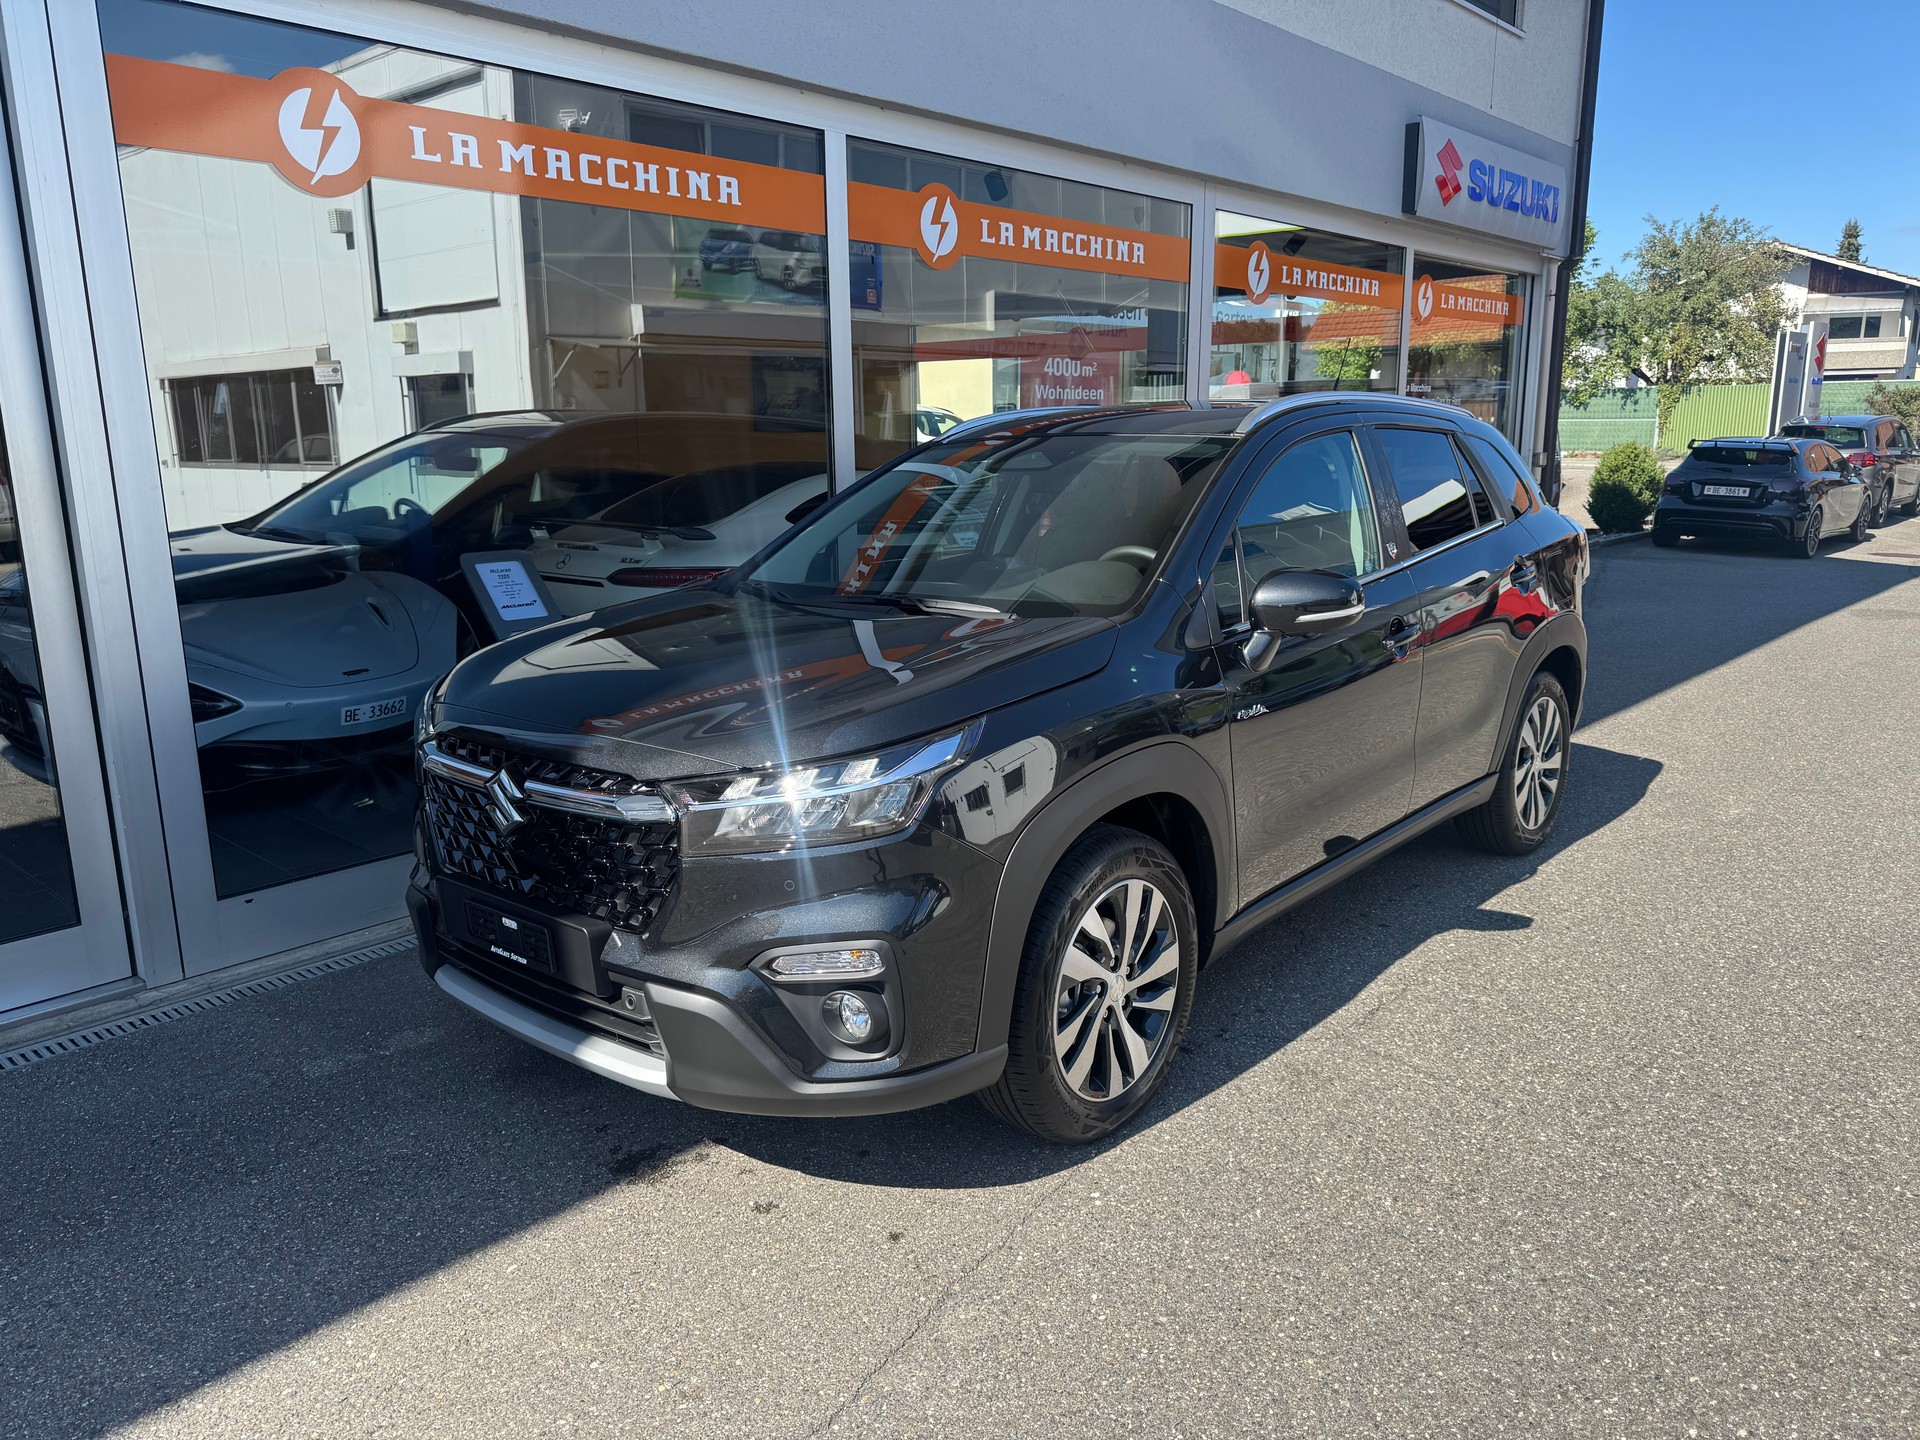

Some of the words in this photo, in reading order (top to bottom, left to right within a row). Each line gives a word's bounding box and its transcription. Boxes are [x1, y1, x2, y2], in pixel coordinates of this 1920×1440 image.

[408, 125, 483, 169] LA
[496, 139, 742, 206] MACCHINA
[1467, 158, 1560, 224] SUZUKI
[980, 218, 1015, 247] LA
[1022, 225, 1146, 265] MACCHINA
[1281, 265, 1302, 286] LA
[1306, 269, 1380, 297] MACCHINA
[1440, 293, 1455, 309] LA
[1457, 296, 1510, 316] MACCHINA
[1035, 384, 1105, 401] Wohnideen
[500, 600, 538, 610] McLaren
